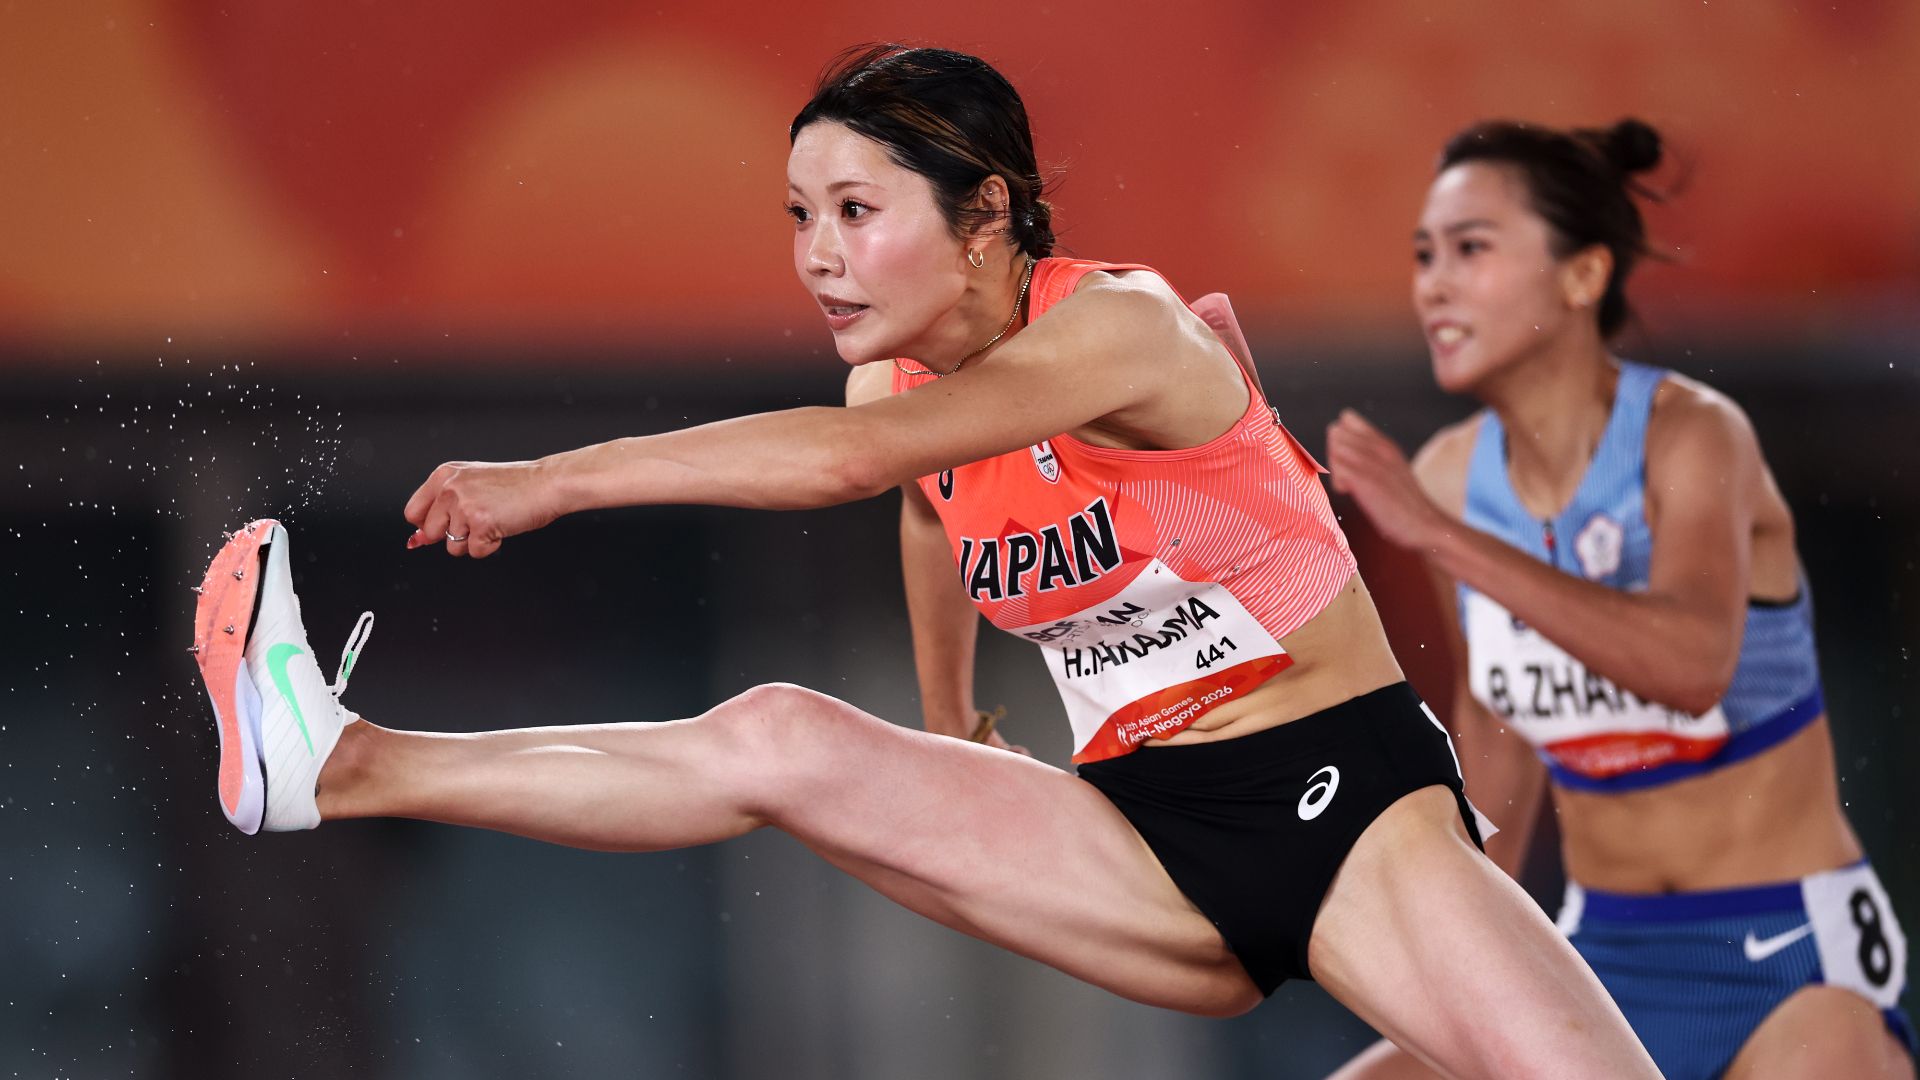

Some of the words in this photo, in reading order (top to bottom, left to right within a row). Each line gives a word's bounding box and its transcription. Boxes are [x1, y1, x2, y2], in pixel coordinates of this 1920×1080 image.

[959, 496, 1123, 602] JAPAN
[1196, 636, 1237, 669] 441
[1201, 686, 1233, 704] 2026
[1138, 712, 1162, 727] Asian
[1161, 697, 1194, 716] Games
[1850, 888, 1892, 989] 8
